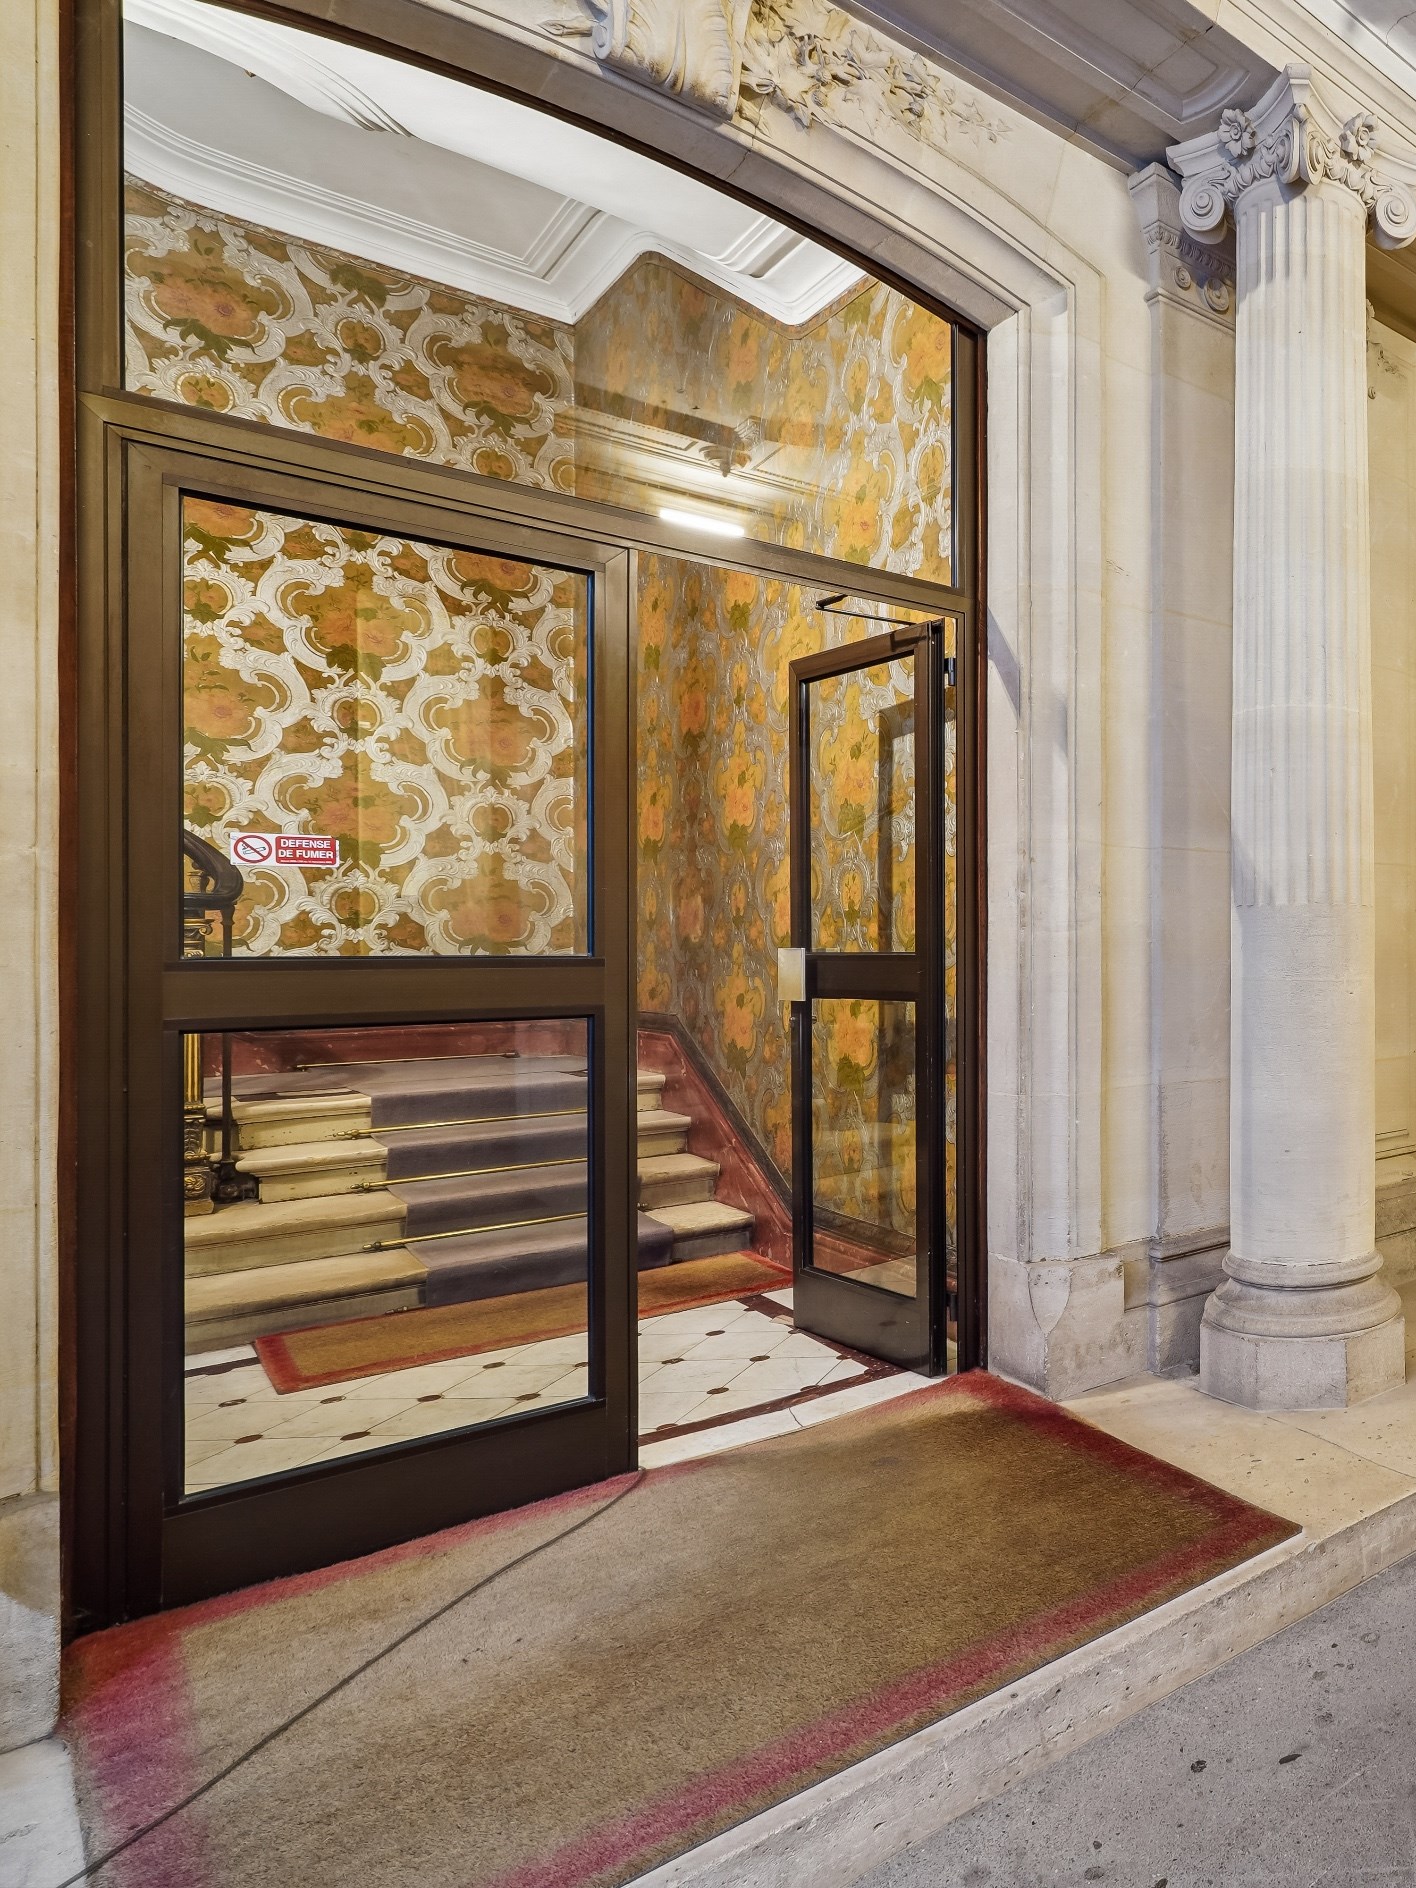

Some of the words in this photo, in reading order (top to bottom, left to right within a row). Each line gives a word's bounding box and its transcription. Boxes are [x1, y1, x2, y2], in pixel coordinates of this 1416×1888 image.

[281, 839, 331, 849] DEFENSE
[278, 850, 293, 858] DE
[296, 850, 334, 859] FUMER
